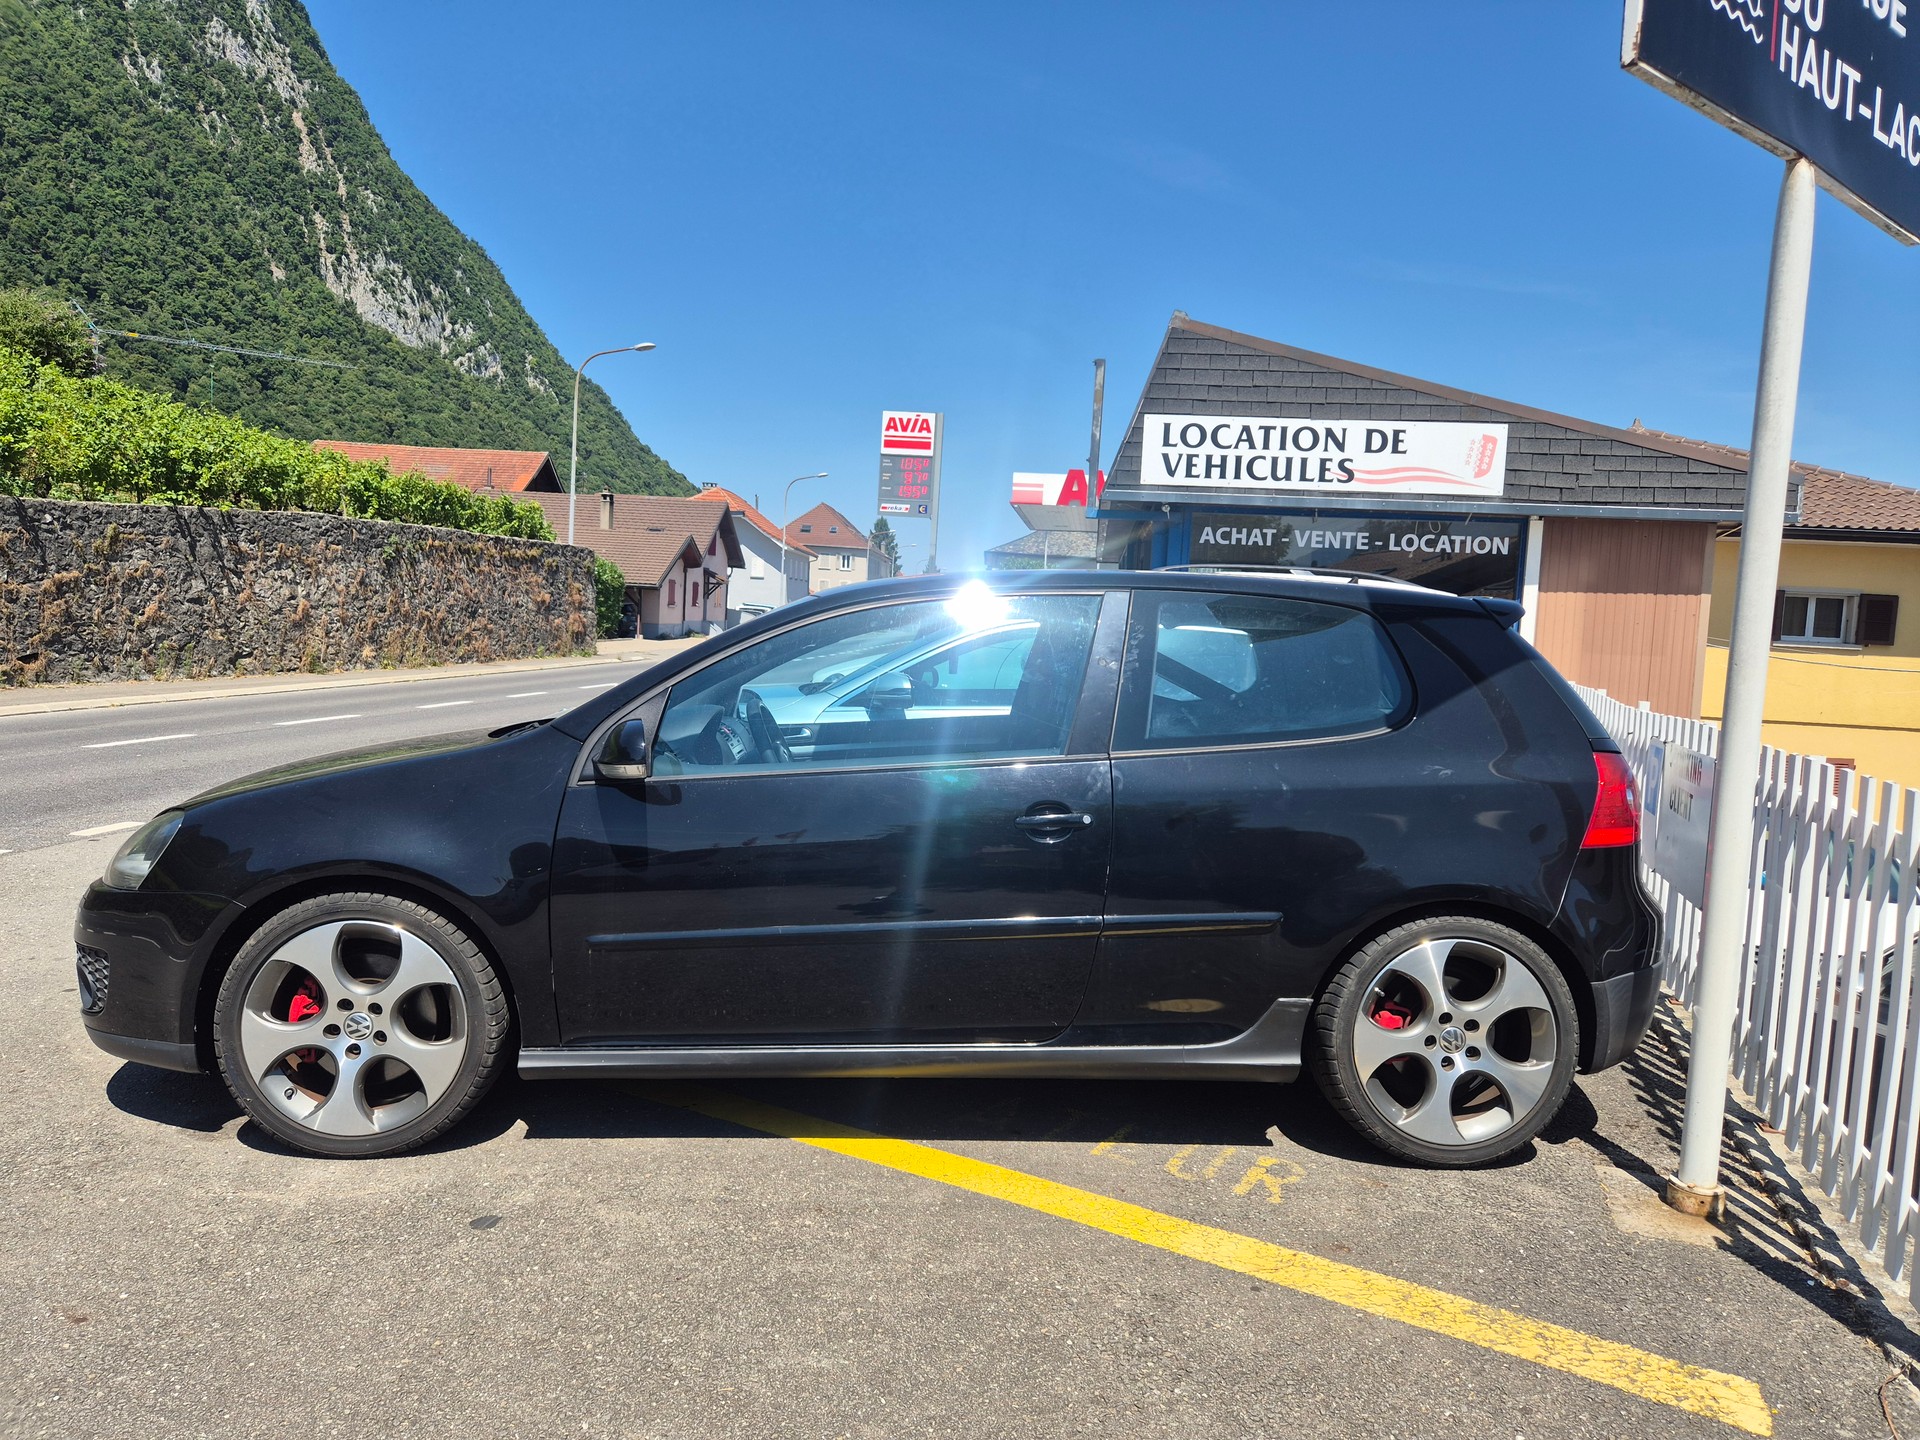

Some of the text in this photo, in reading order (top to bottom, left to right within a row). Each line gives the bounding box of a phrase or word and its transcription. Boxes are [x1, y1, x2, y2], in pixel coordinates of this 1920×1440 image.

[1779, 14, 1920, 167] HAUT-LAC
[885, 414, 932, 434] AVIA
[1162, 422, 1408, 454] LOCATION DE
[1161, 453, 1355, 483] VEHICULES
[1199, 526, 1276, 546] ACHAT
[1294, 530, 1369, 550] VENTE
[1388, 533, 1510, 555] LOCATION
